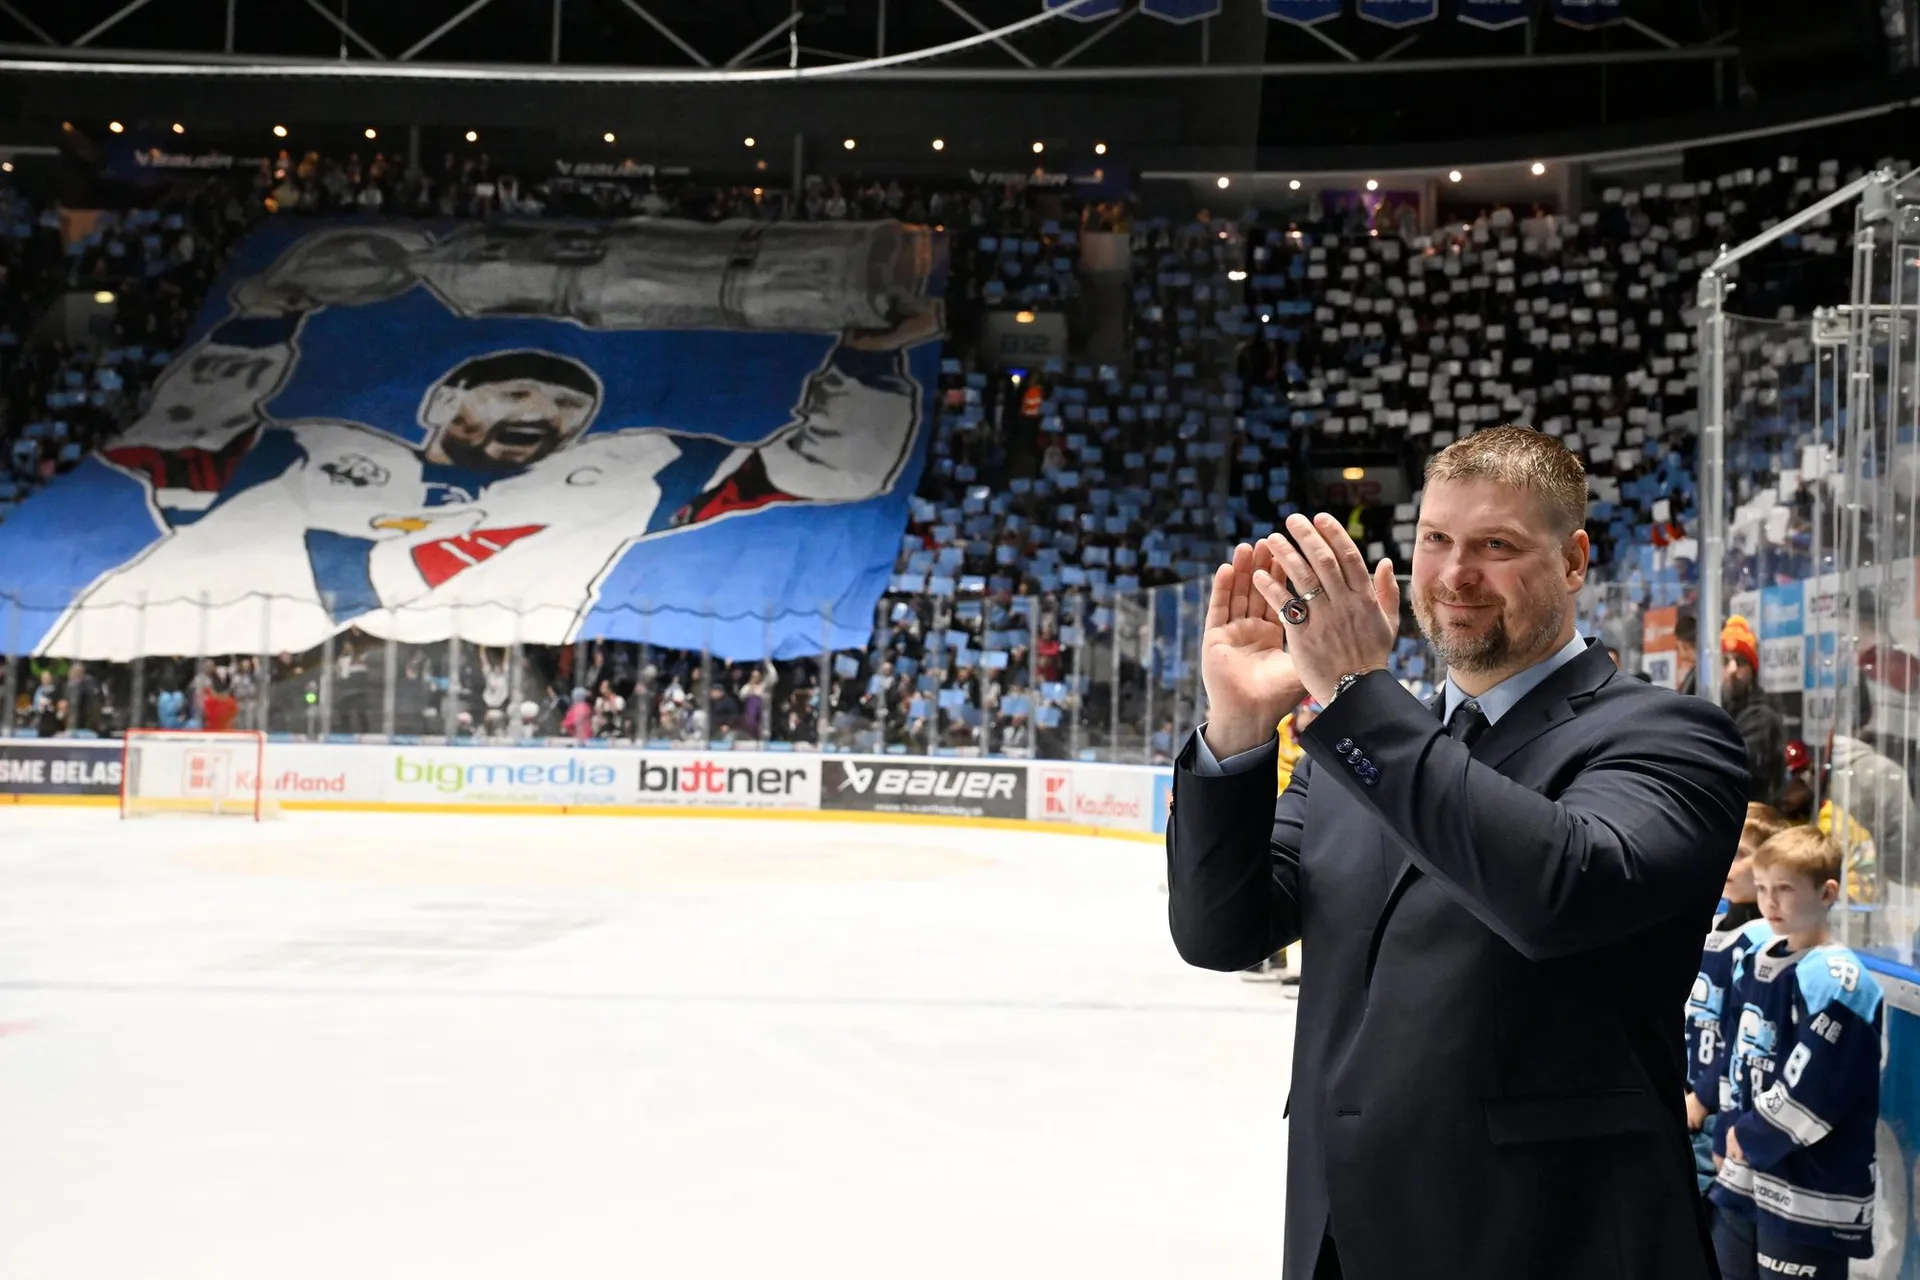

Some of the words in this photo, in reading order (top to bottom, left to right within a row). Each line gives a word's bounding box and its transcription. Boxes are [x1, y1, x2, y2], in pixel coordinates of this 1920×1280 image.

[394, 755, 616, 793] bigmedia
[1698, 1029, 1716, 1066] 8
[1784, 1042, 1812, 1089] 8
